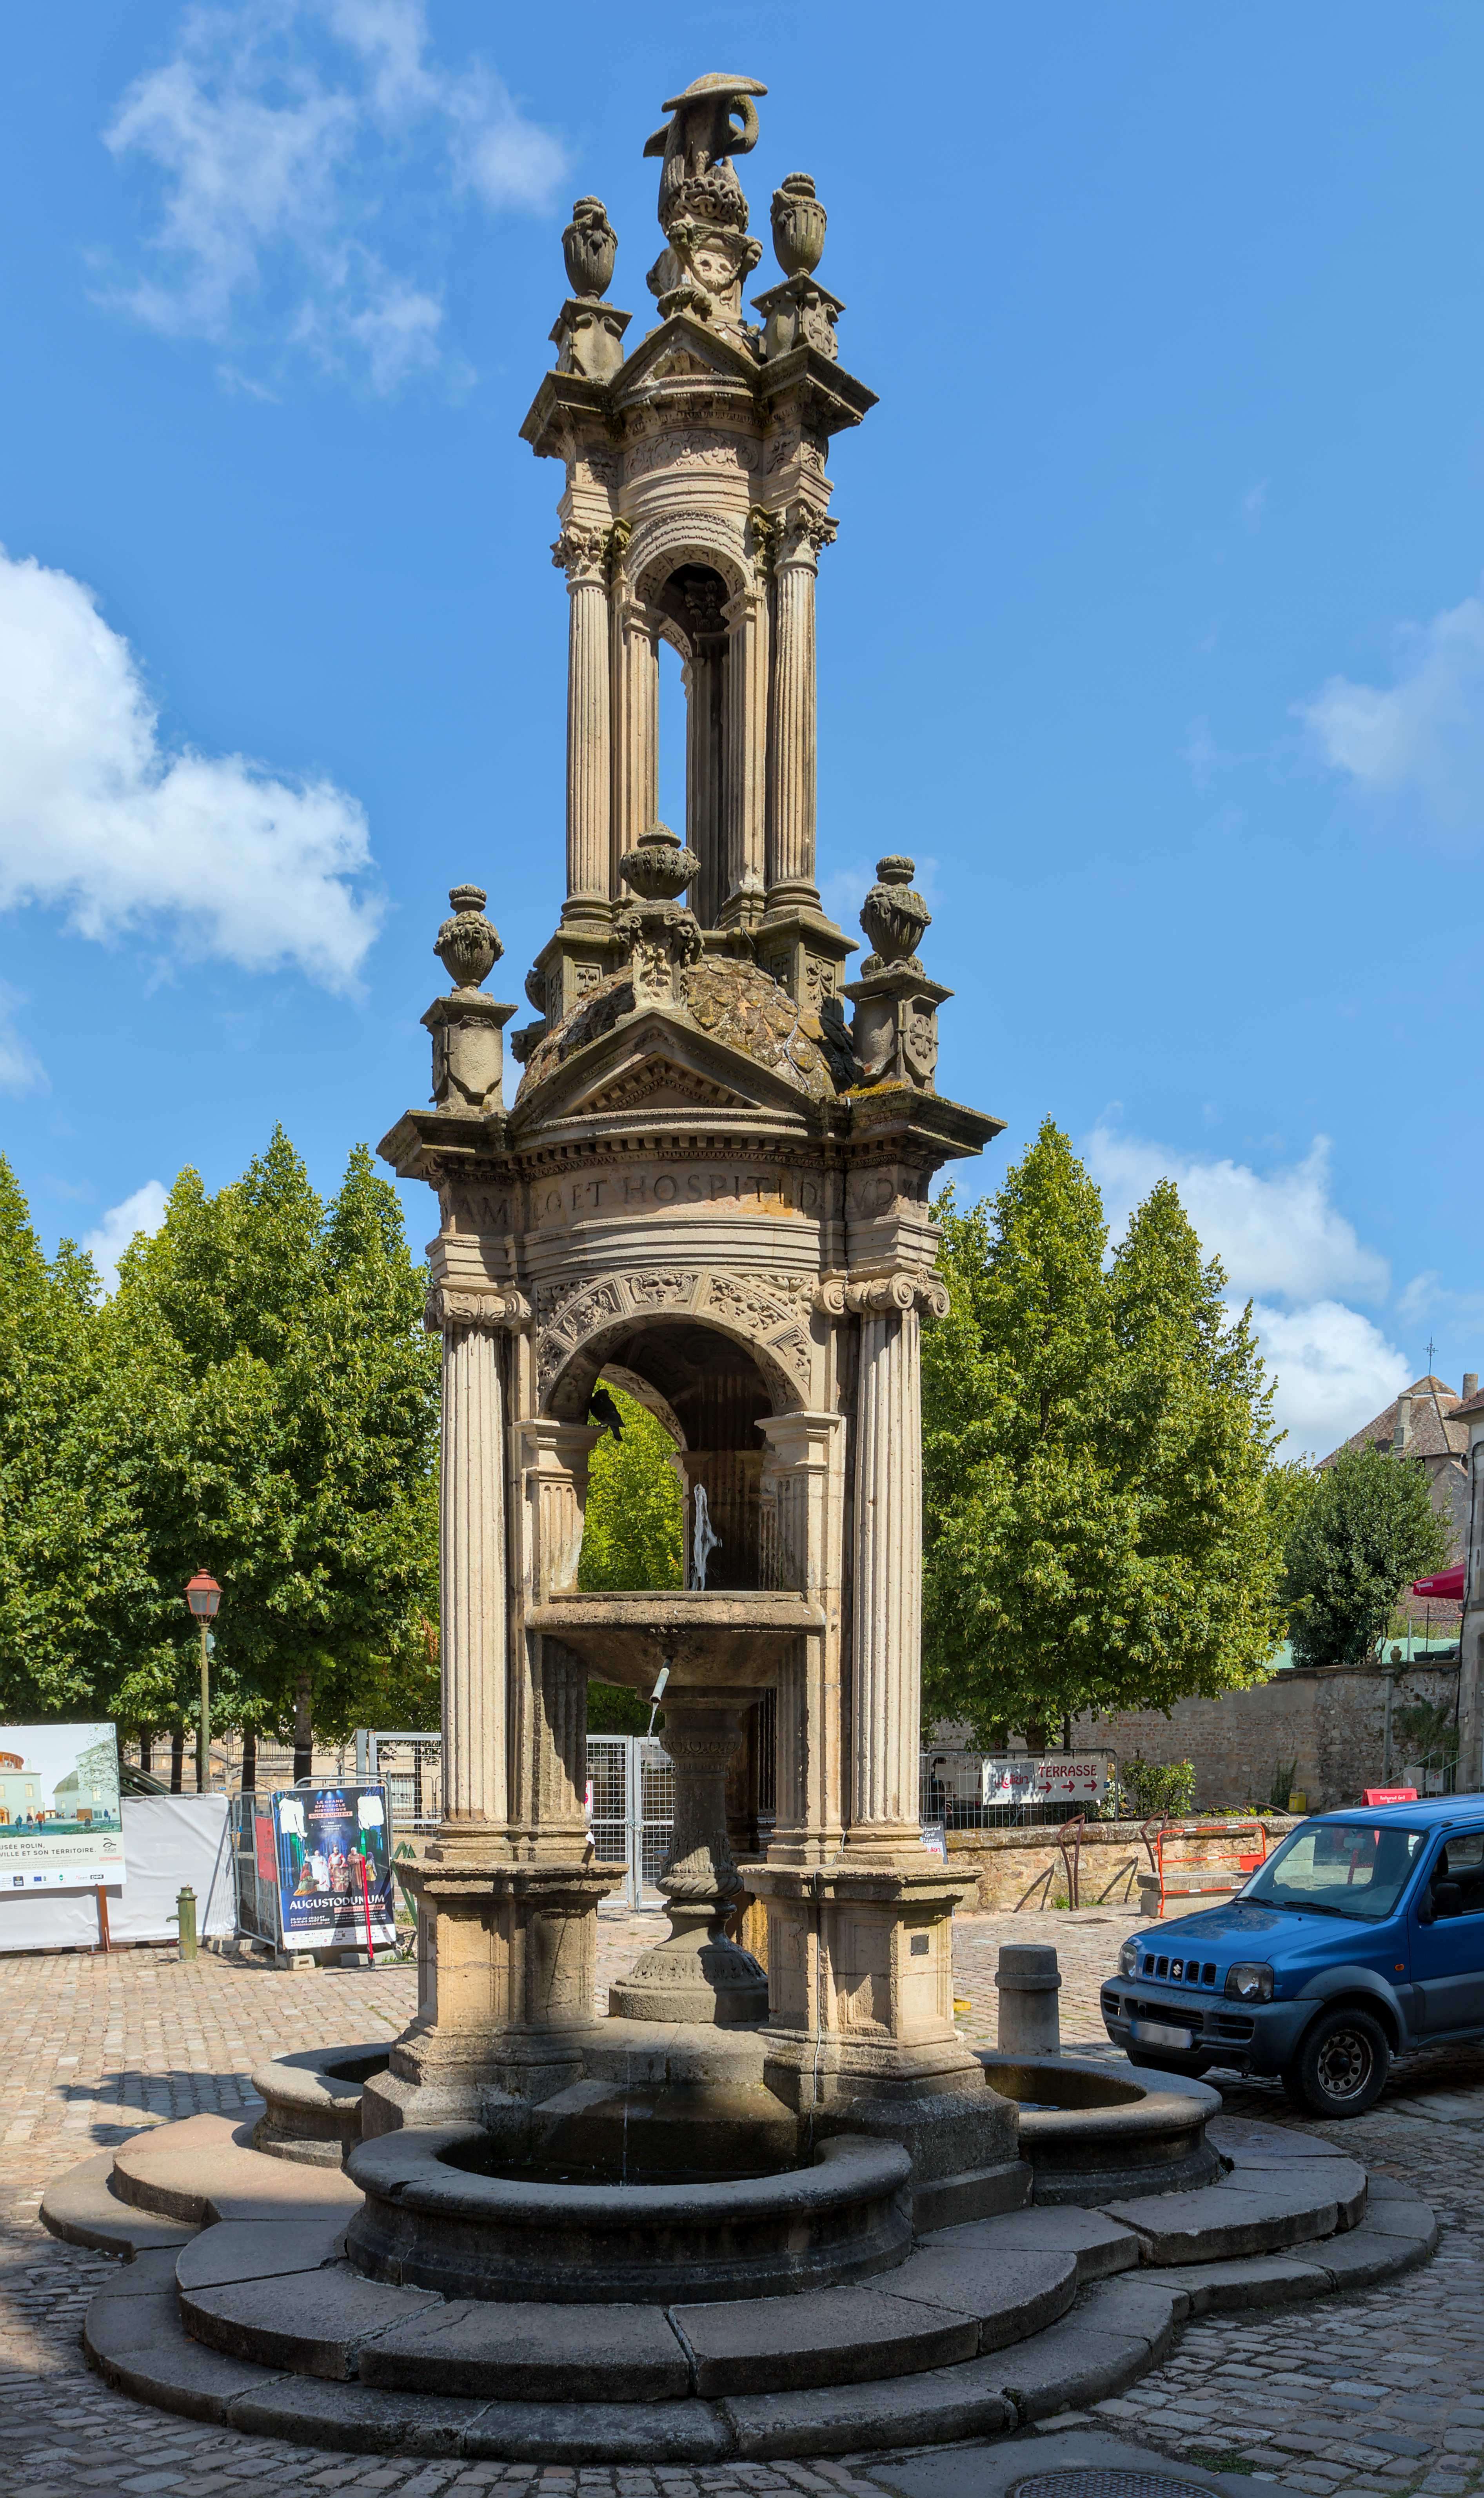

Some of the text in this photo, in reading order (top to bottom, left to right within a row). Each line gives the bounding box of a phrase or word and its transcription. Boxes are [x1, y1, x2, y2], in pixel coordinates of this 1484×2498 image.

[572, 1180, 607, 1211] ET
[1039, 1765, 1097, 1778] TERRASSE
[289, 1894, 385, 1910] AUGUSTODUNUM
